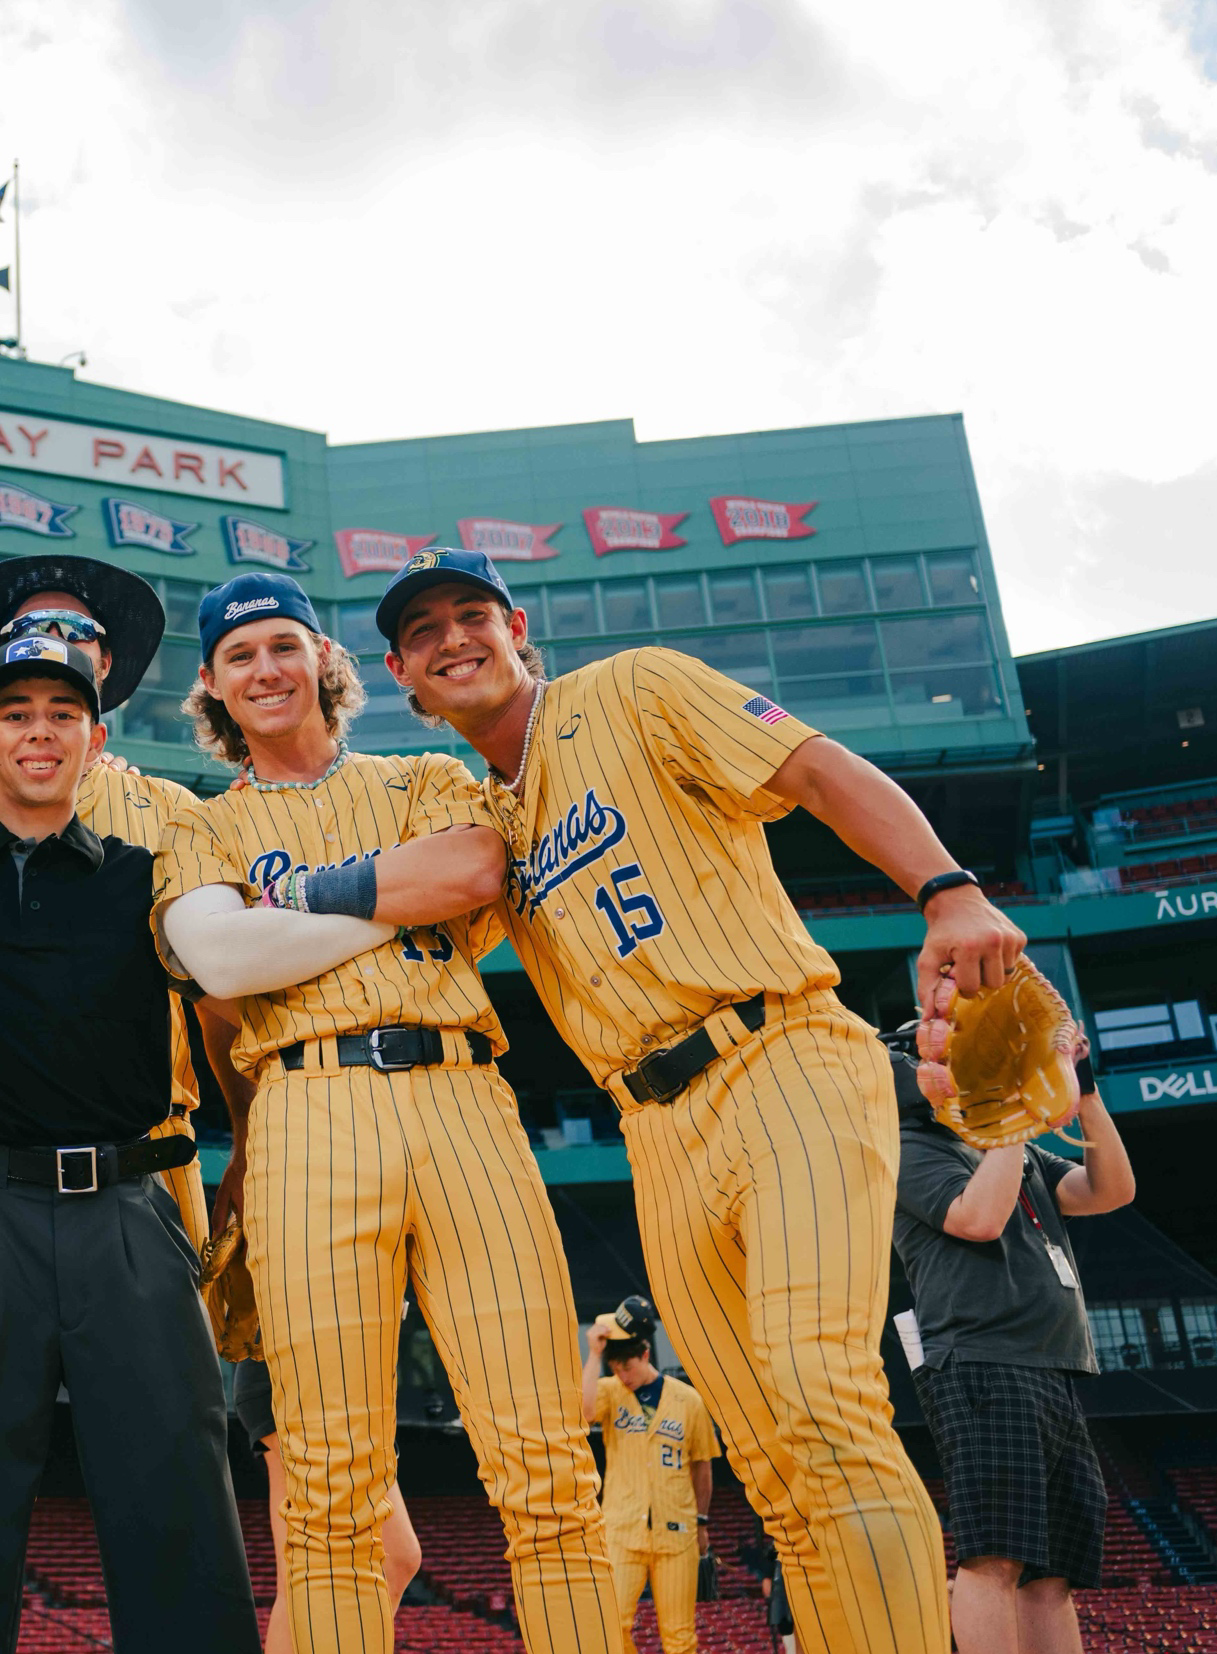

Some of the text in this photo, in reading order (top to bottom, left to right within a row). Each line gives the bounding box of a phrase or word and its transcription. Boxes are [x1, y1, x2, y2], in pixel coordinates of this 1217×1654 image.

[92, 438, 248, 490] PARK
[224, 596, 280, 621] Bananas
[595, 863, 665, 959] 15
[1139, 1070, 1217, 1101] DELL
[660, 1445, 682, 1470] 21
